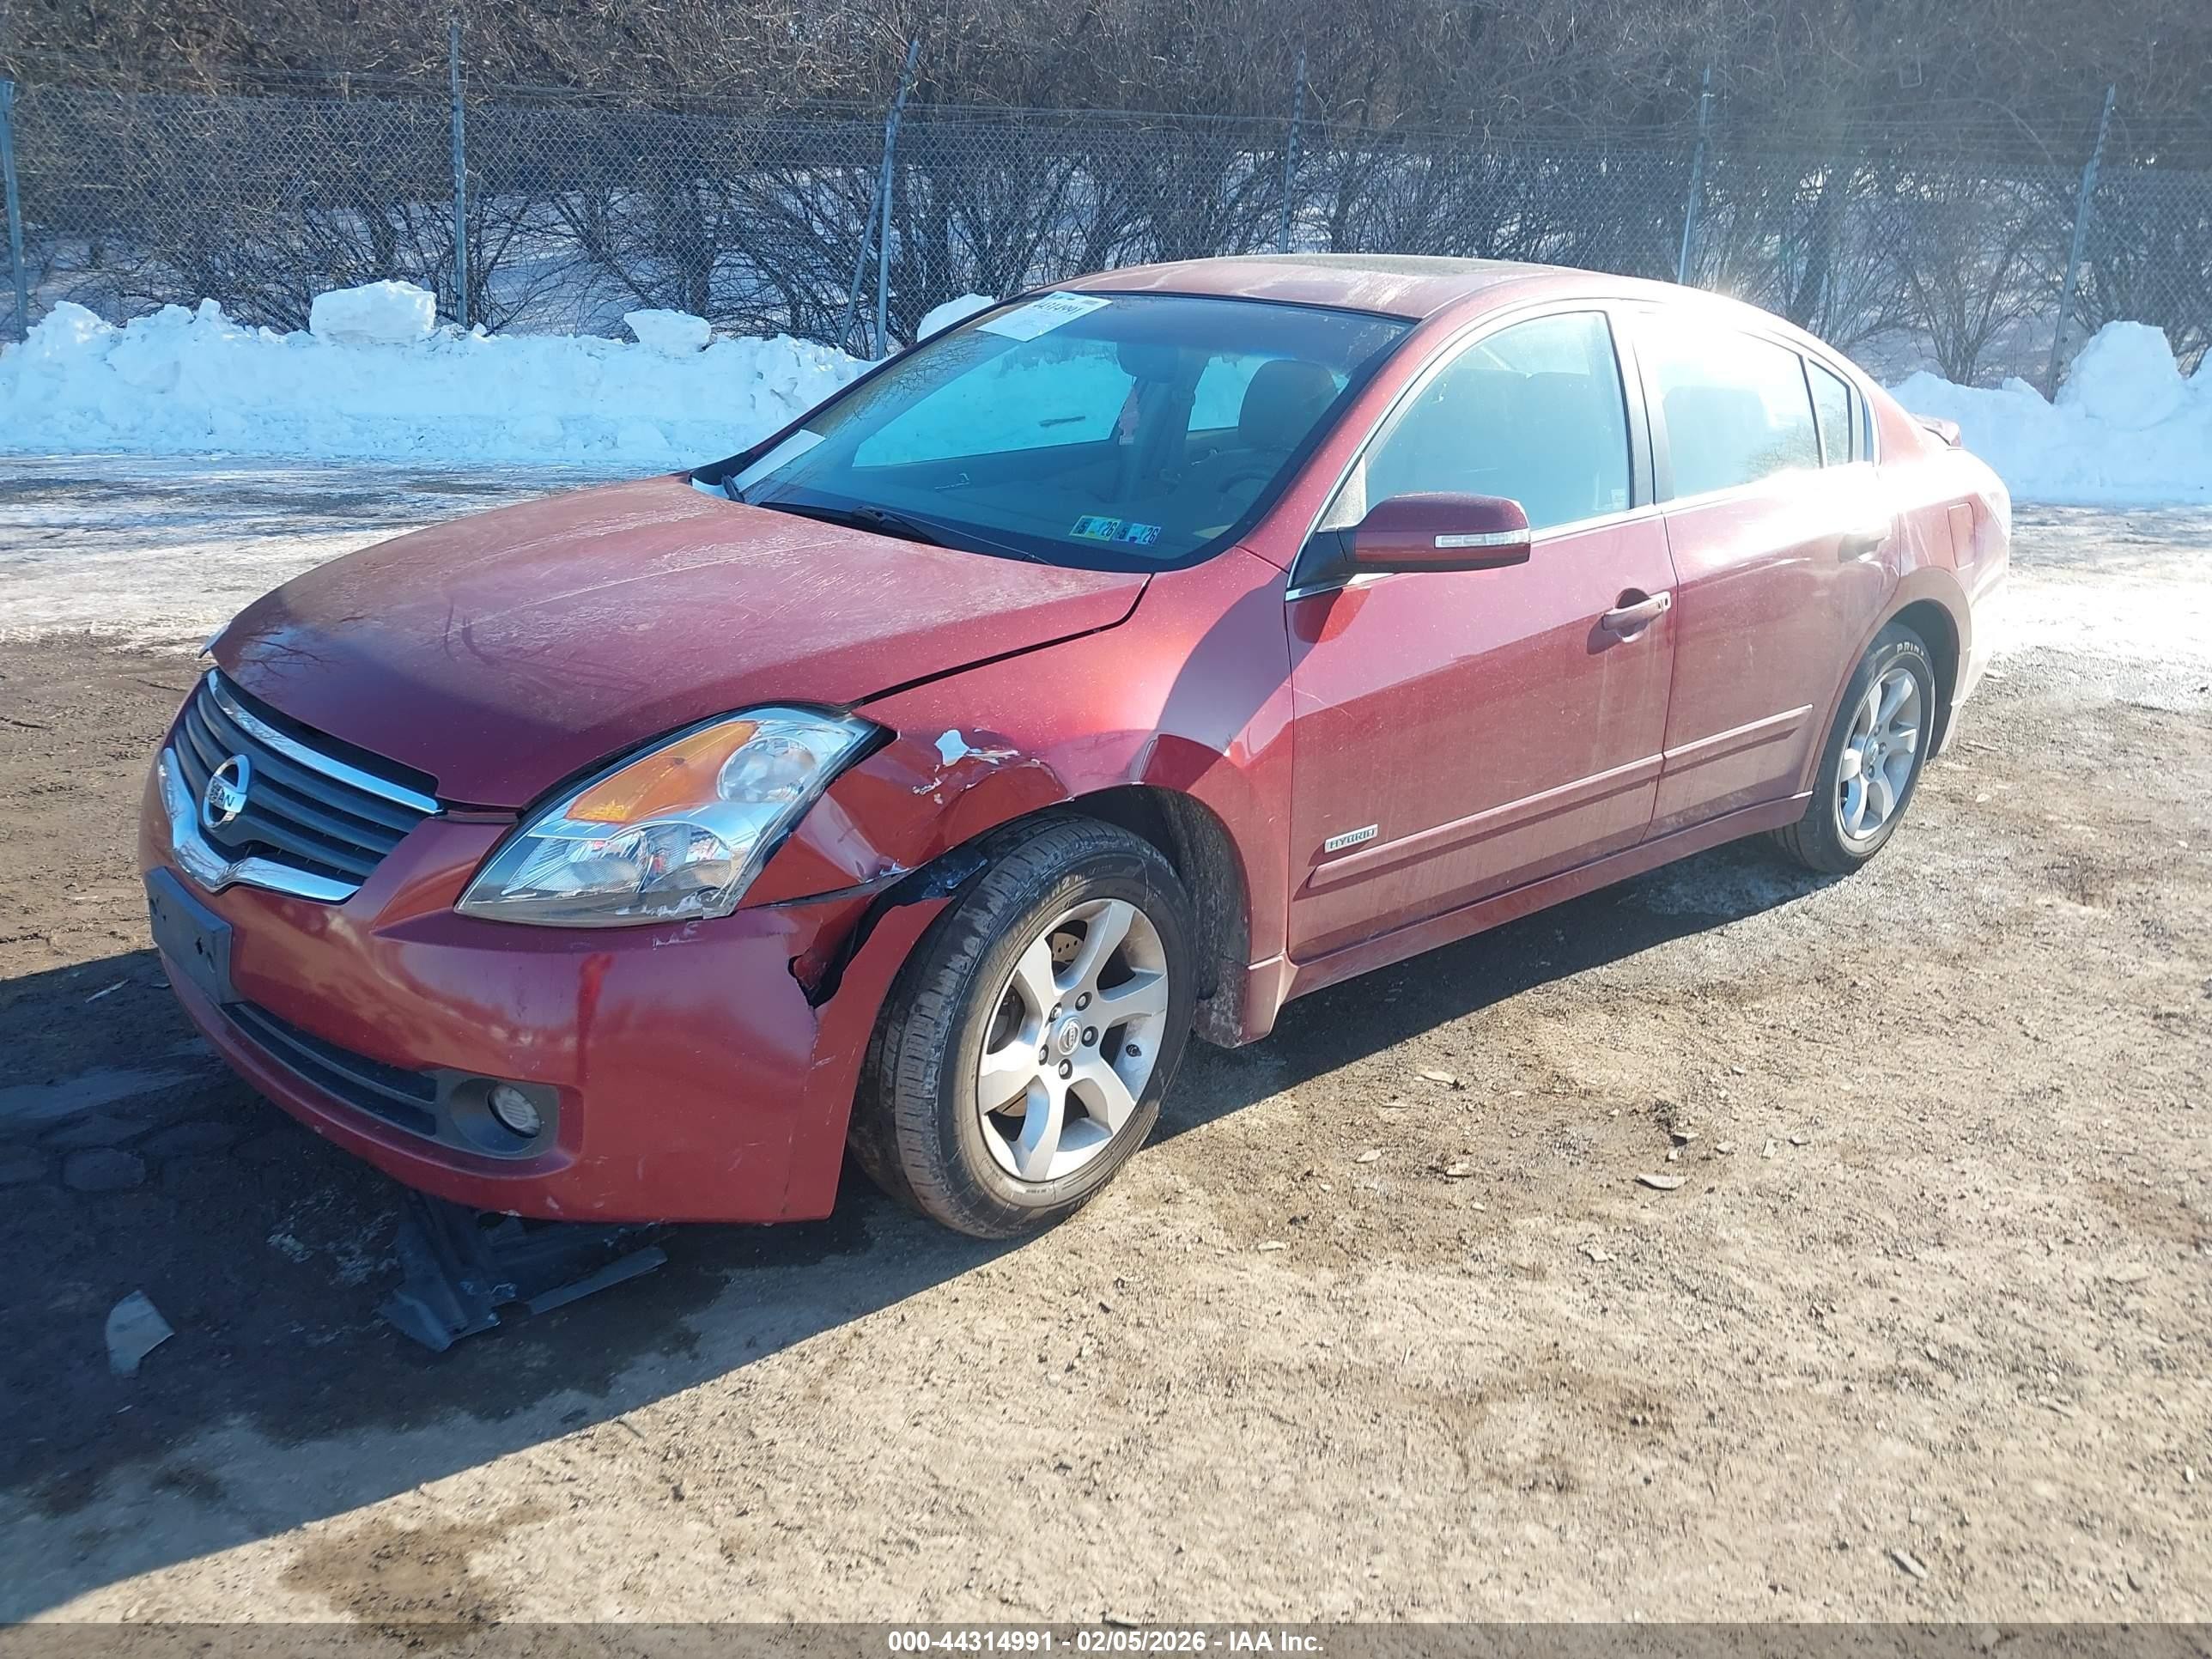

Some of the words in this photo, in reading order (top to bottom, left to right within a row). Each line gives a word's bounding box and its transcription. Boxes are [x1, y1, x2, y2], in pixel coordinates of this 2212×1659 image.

[1078, 521, 1088, 534] 5
[1101, 520, 1117, 537] 26
[1118, 527, 1127, 540] 5
[1143, 528, 1158, 544] 26
[1330, 828, 1375, 849] HYBRID
